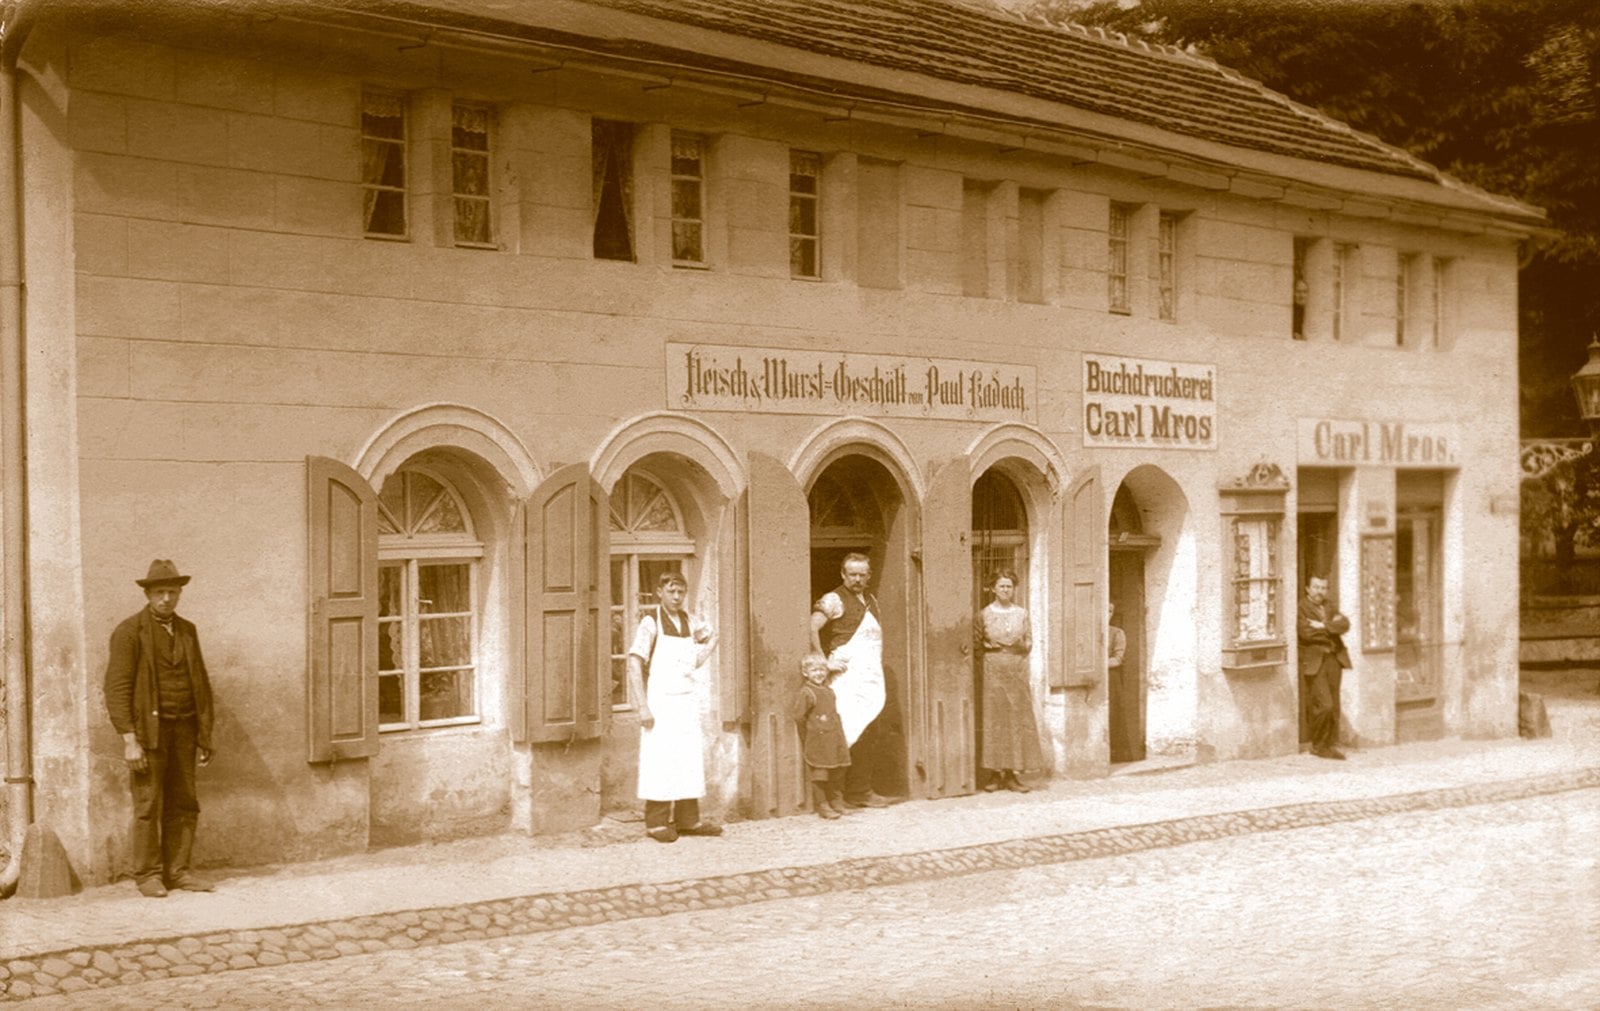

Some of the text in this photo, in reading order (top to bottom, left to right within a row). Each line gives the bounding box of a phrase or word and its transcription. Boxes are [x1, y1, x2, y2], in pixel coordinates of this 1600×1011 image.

[680, 345, 748, 408] Fleisch
[750, 375, 764, 408] &
[922, 365, 963, 413] Paul
[1086, 361, 1214, 402] Buchdruckerei
[1086, 402, 1213, 441] Carl Mros
[1314, 419, 1370, 462] Carl
